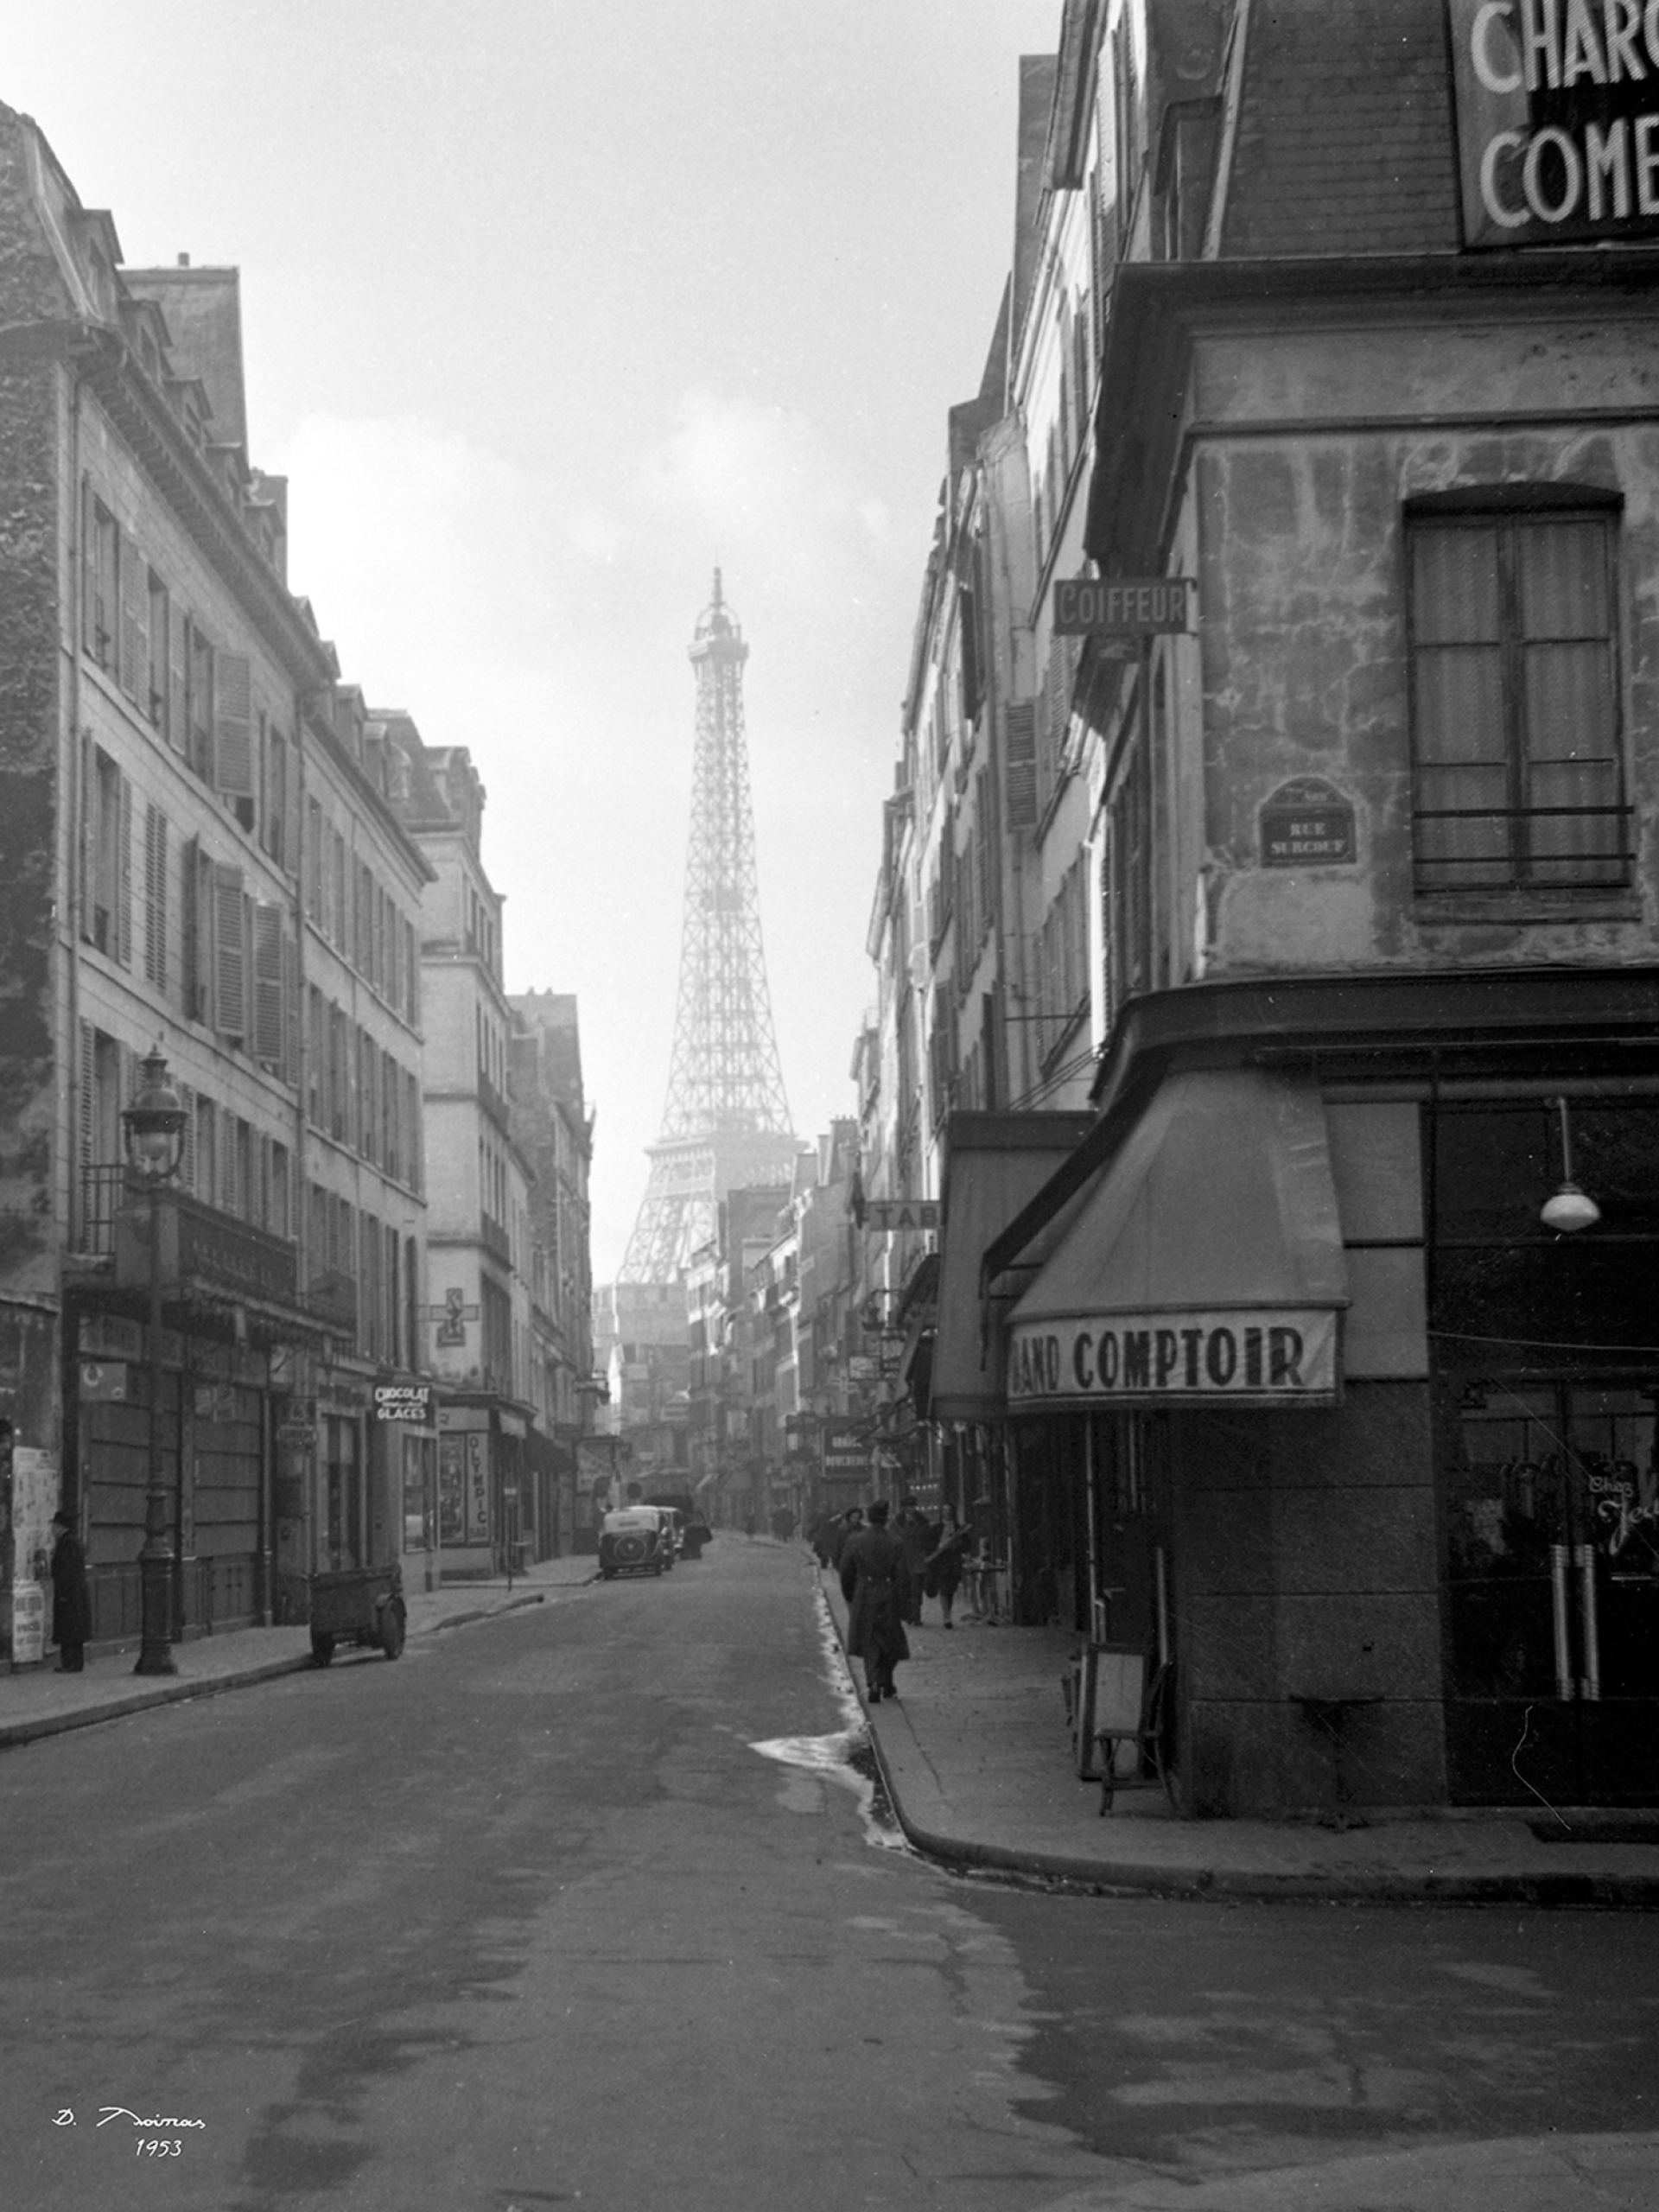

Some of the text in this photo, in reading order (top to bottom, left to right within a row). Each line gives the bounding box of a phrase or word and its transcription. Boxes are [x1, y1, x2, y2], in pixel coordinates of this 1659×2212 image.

[1059, 584, 1185, 624] COIFFEUR
[1290, 823, 1325, 836] RUE
[1073, 1327, 1305, 1389] COMPTOIR
[375, 1386, 429, 1403] CHOCOLAT
[378, 1408, 427, 1420] GLACES
[469, 1436, 487, 1524] OLYMPIC
